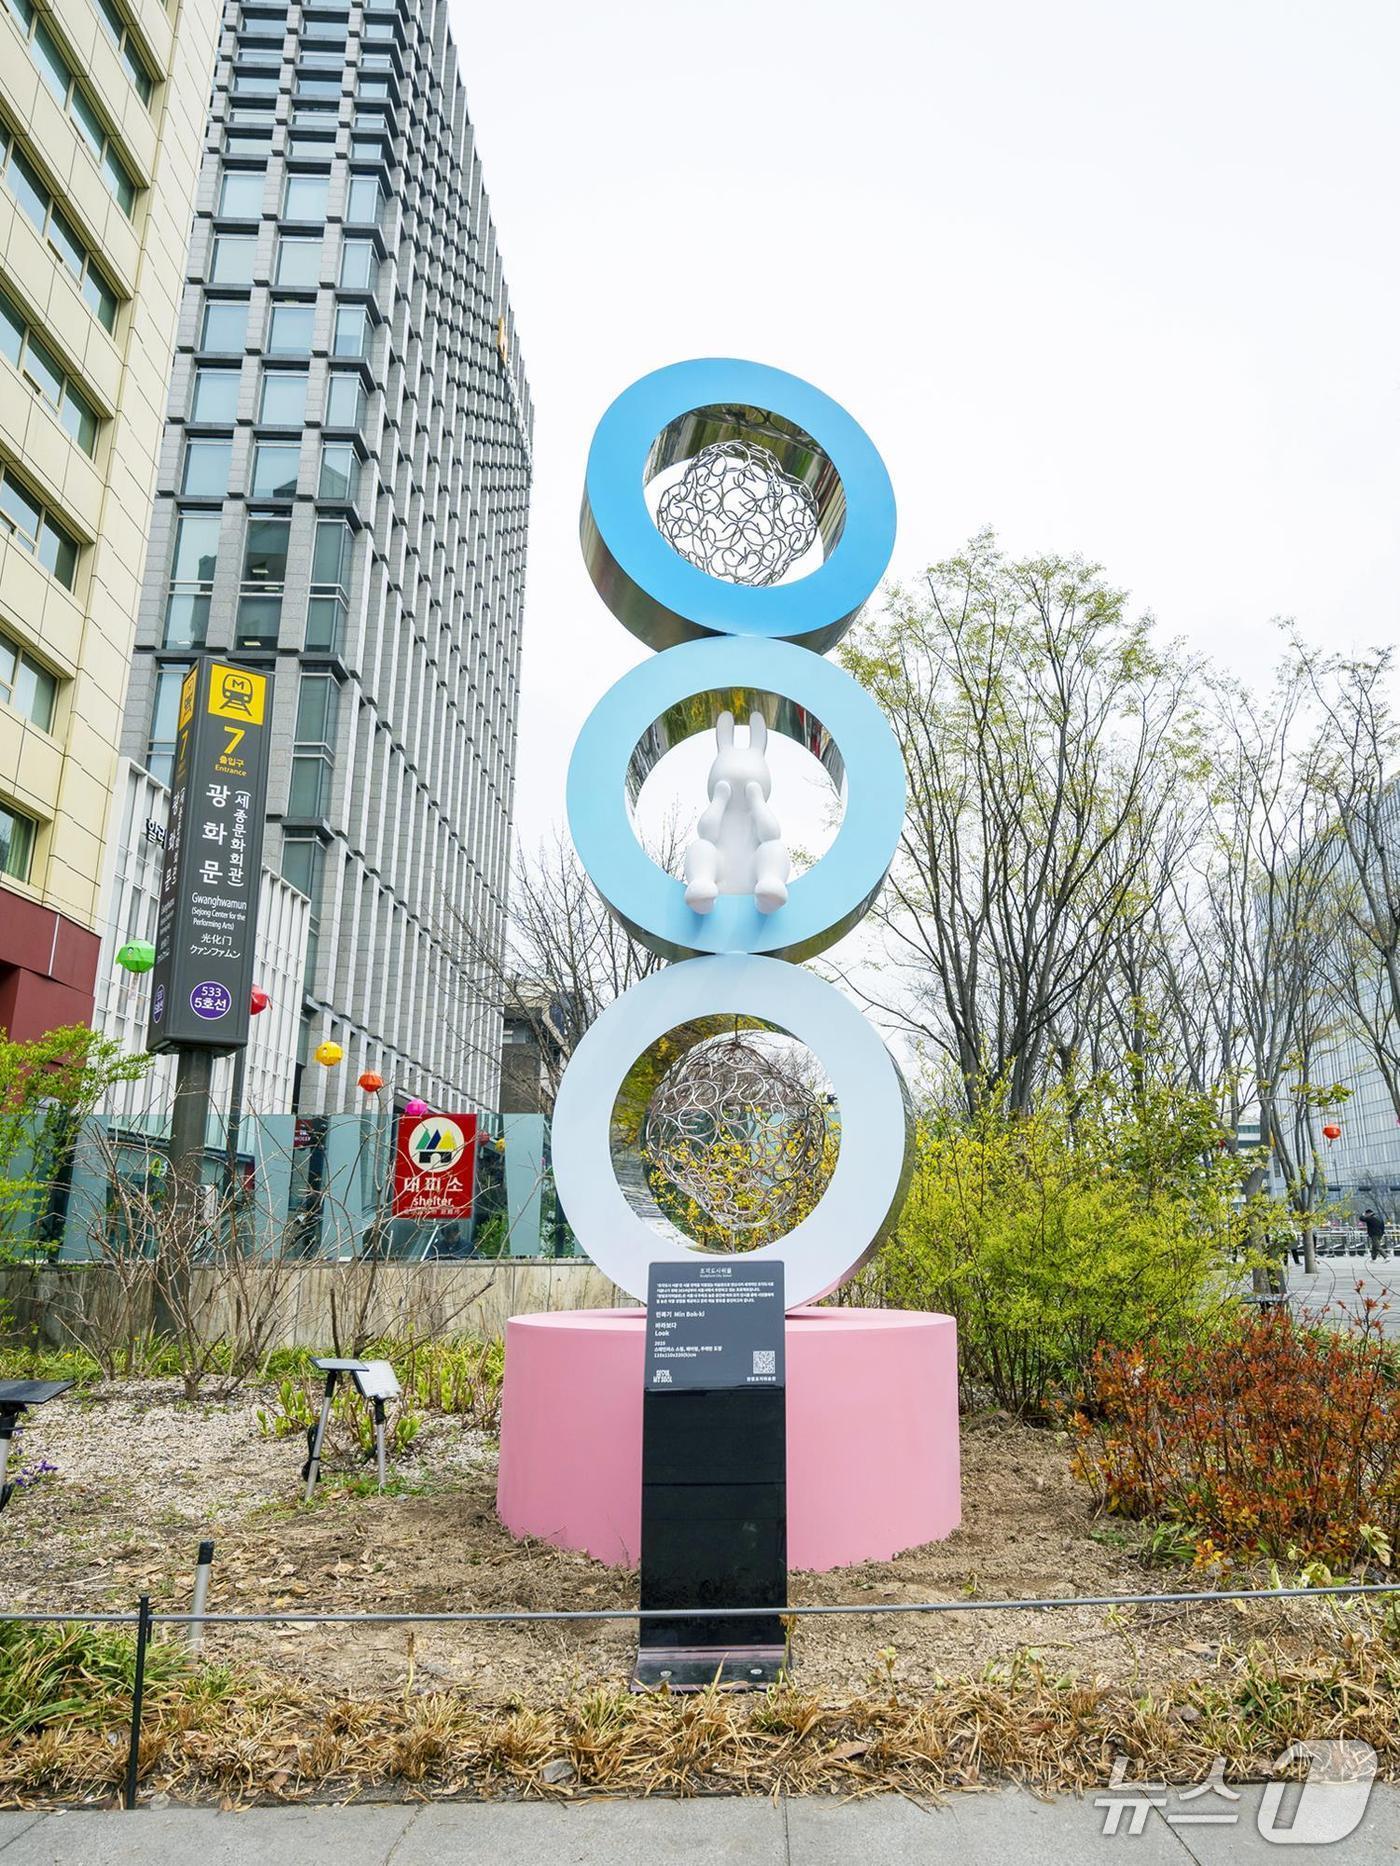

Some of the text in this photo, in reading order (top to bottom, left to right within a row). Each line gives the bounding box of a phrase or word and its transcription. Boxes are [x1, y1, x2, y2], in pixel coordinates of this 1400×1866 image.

[224, 725, 245, 754] 7
[219, 755, 245, 767] 출입구
[215, 764, 247, 776] Entrance
[199, 783, 231, 885] 광화문
[227, 790, 251, 887] (세종문화회관)
[191, 892, 247, 910] Gwanghwamun
[191, 906, 246, 921] (Sejong Center for the
[193, 917, 235, 931] Performing Arts)
[190, 944, 241, 959] クァンファムン
[201, 986, 222, 997] 533
[194, 997, 227, 1012] 5호선
[404, 1177, 463, 1193] 대피소
[413, 1195, 453, 1206] shelter
